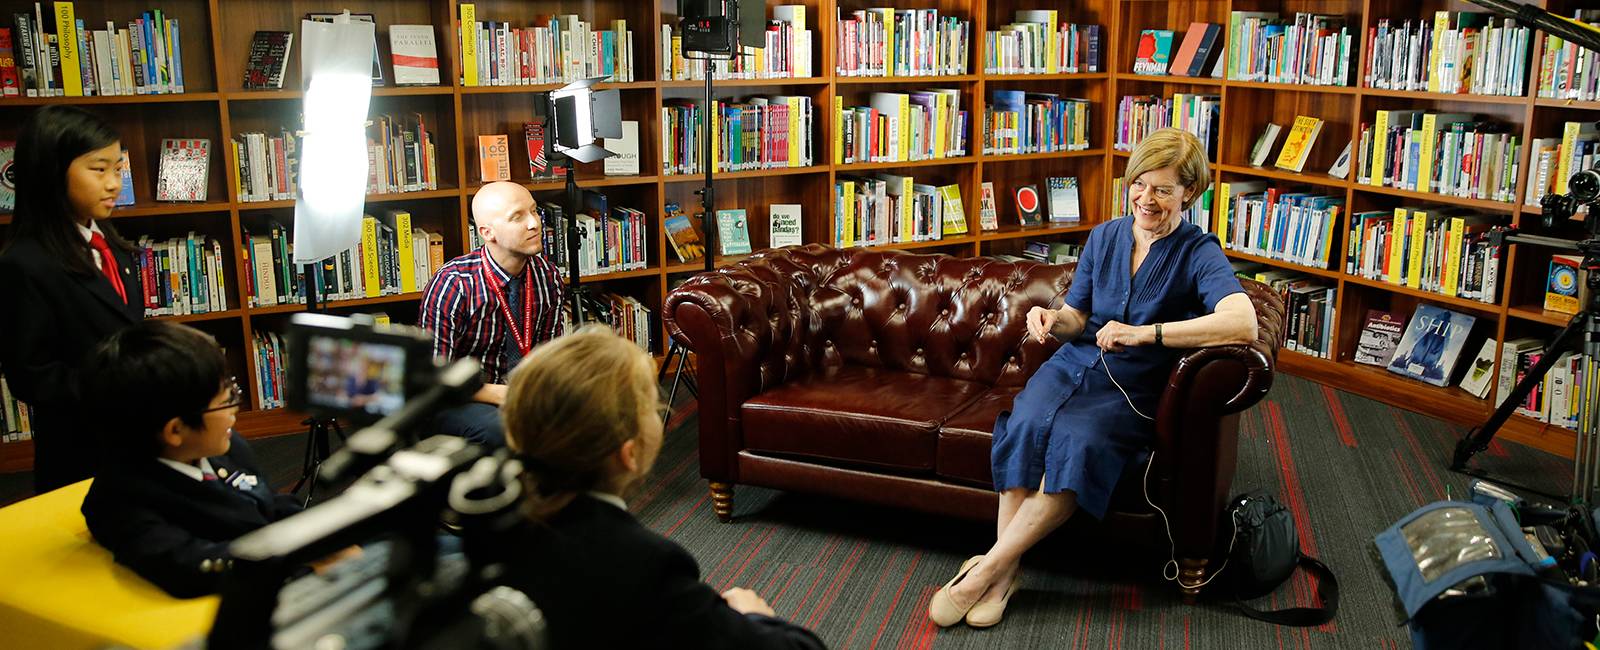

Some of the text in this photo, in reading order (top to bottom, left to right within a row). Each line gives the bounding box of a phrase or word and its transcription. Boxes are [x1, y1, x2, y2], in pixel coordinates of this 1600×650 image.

[18, 16, 32, 65] BREAKING NEWS
[61, 5, 72, 59] 100 Philosophy
[466, 20, 474, 55] Community
[1133, 62, 1167, 73] FEYNMAN
[489, 145, 497, 158] 10
[497, 137, 507, 179] BILLION
[772, 226, 799, 234] pandas?
[1393, 223, 1402, 256] Engineering
[262, 262, 270, 290] HINDUS
[1366, 321, 1400, 332] Antibiotics
[1414, 314, 1463, 339] SHIP
